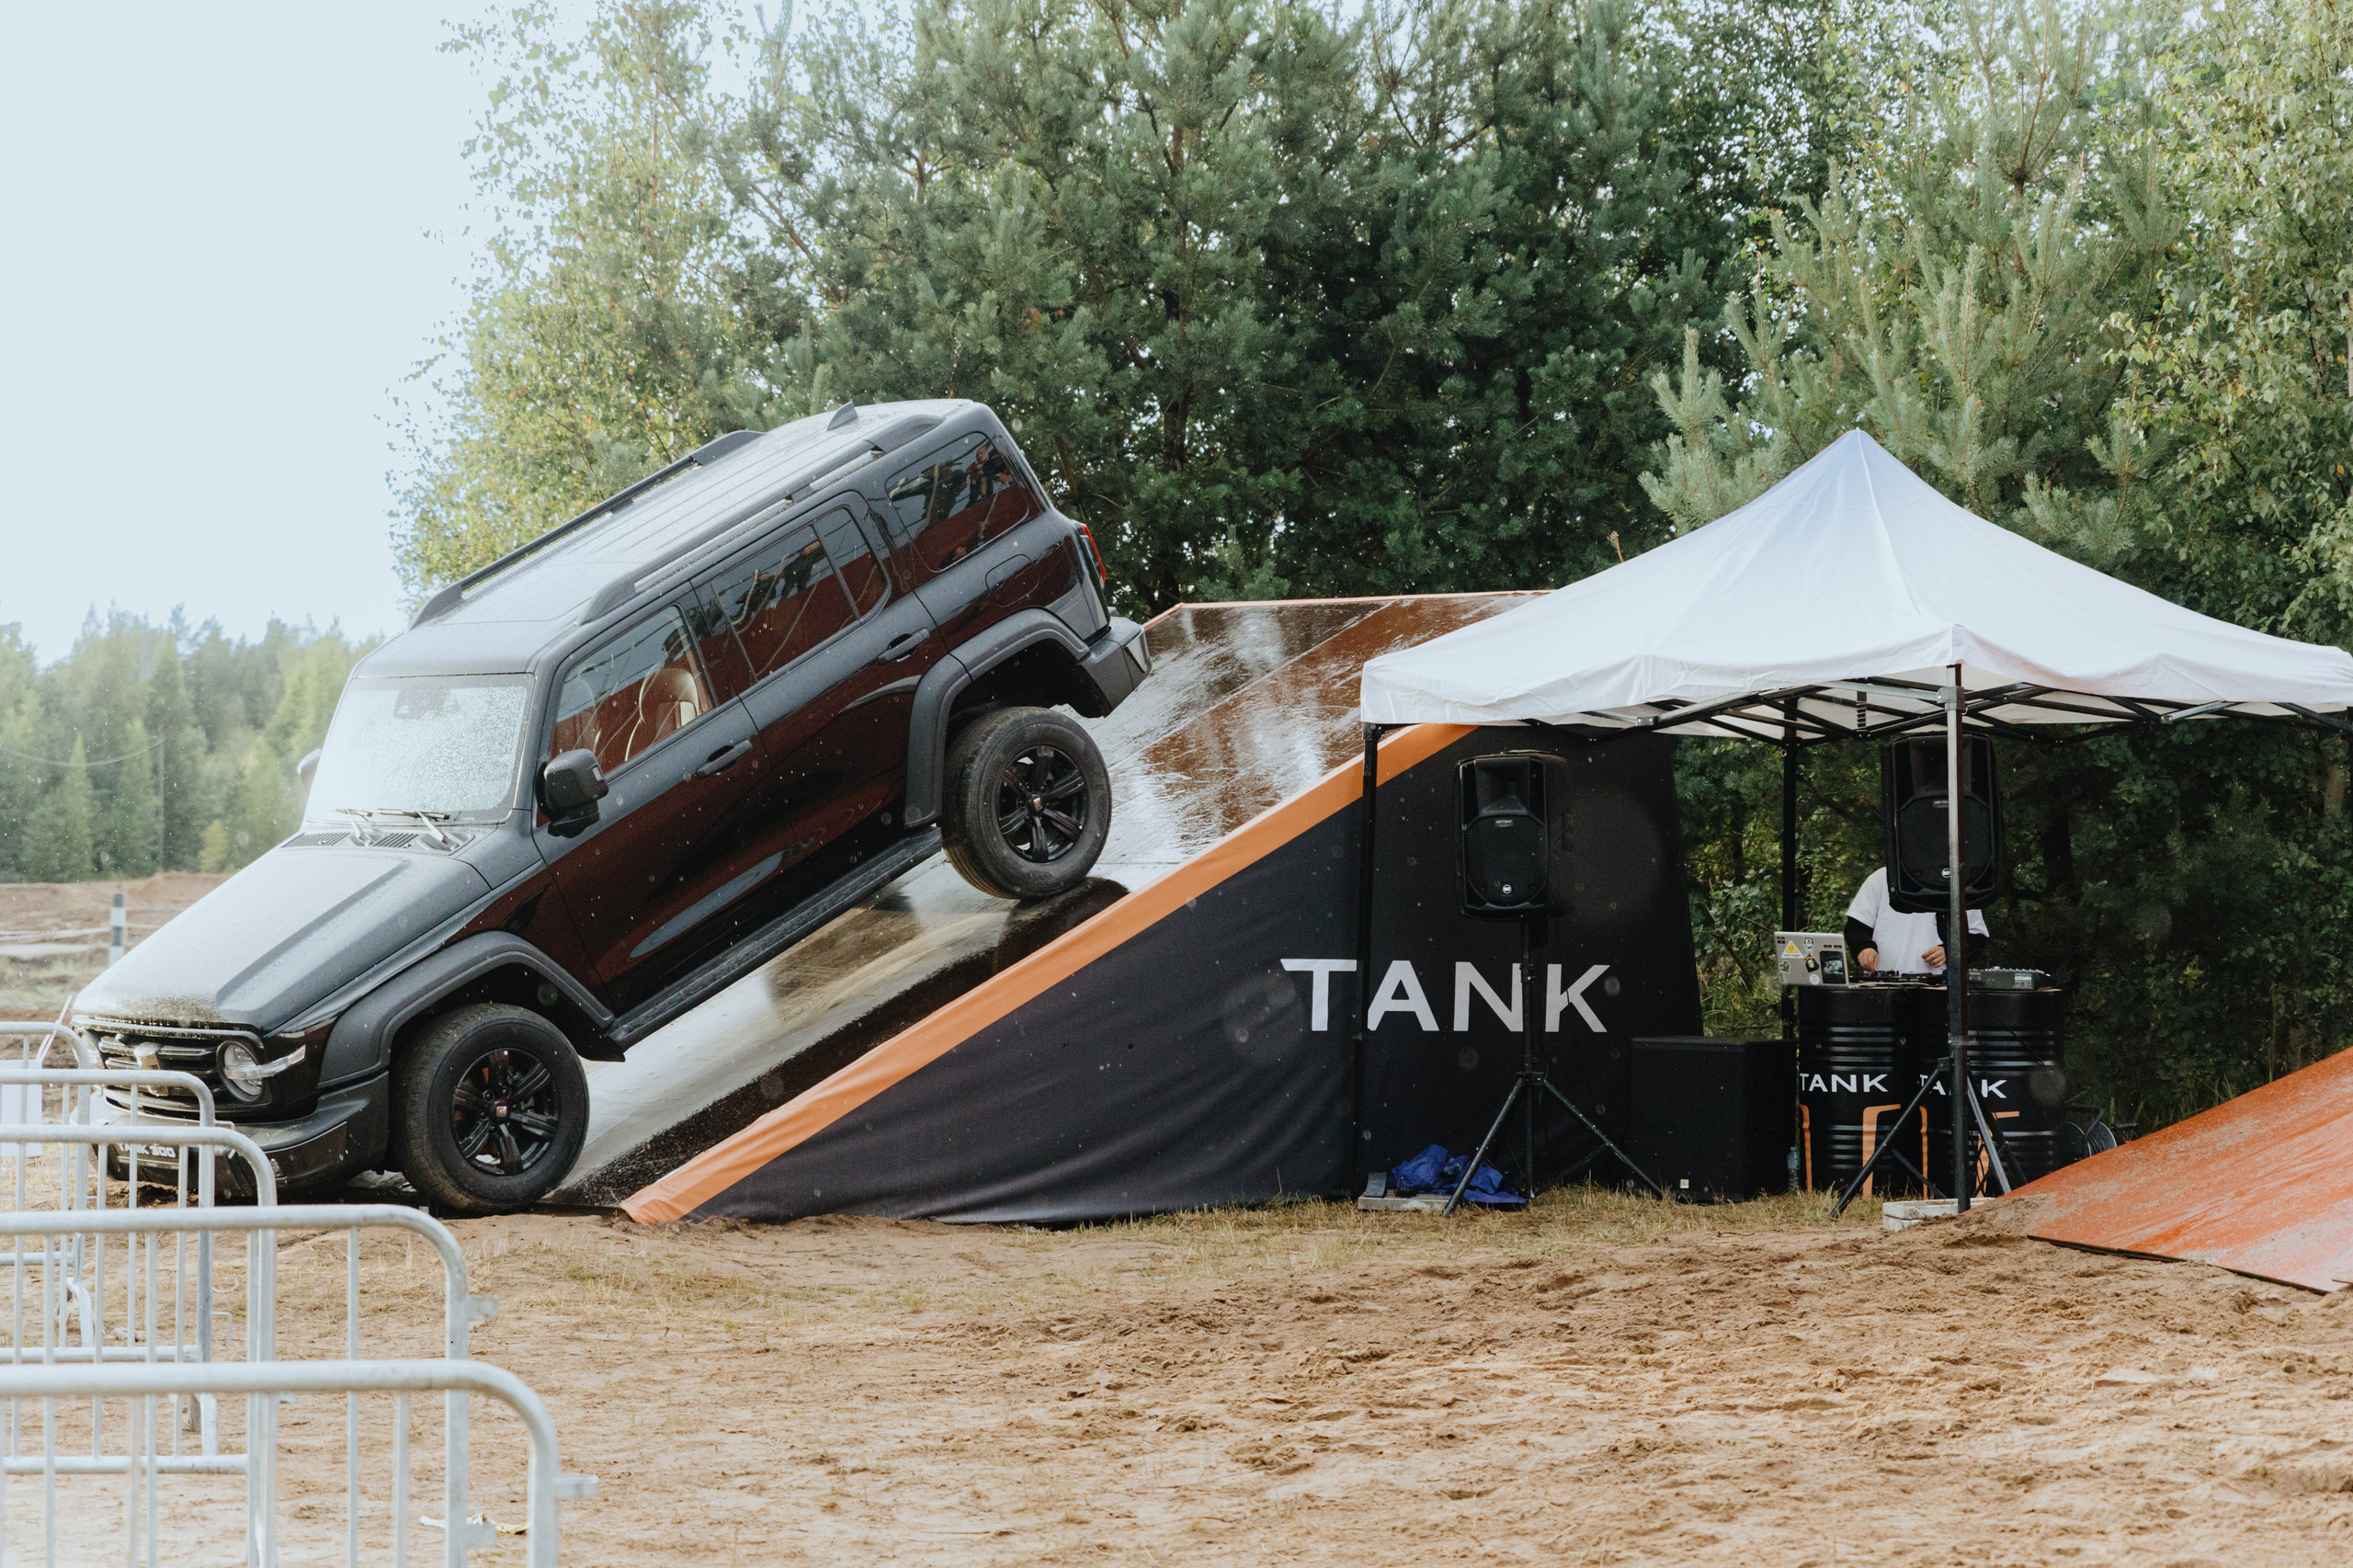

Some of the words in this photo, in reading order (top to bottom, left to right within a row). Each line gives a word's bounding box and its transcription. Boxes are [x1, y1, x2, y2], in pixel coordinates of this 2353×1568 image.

[1280, 959, 1610, 1032] TANK
[1800, 1074, 1889, 1092] TANK
[1919, 1074, 2007, 1098] TAK
